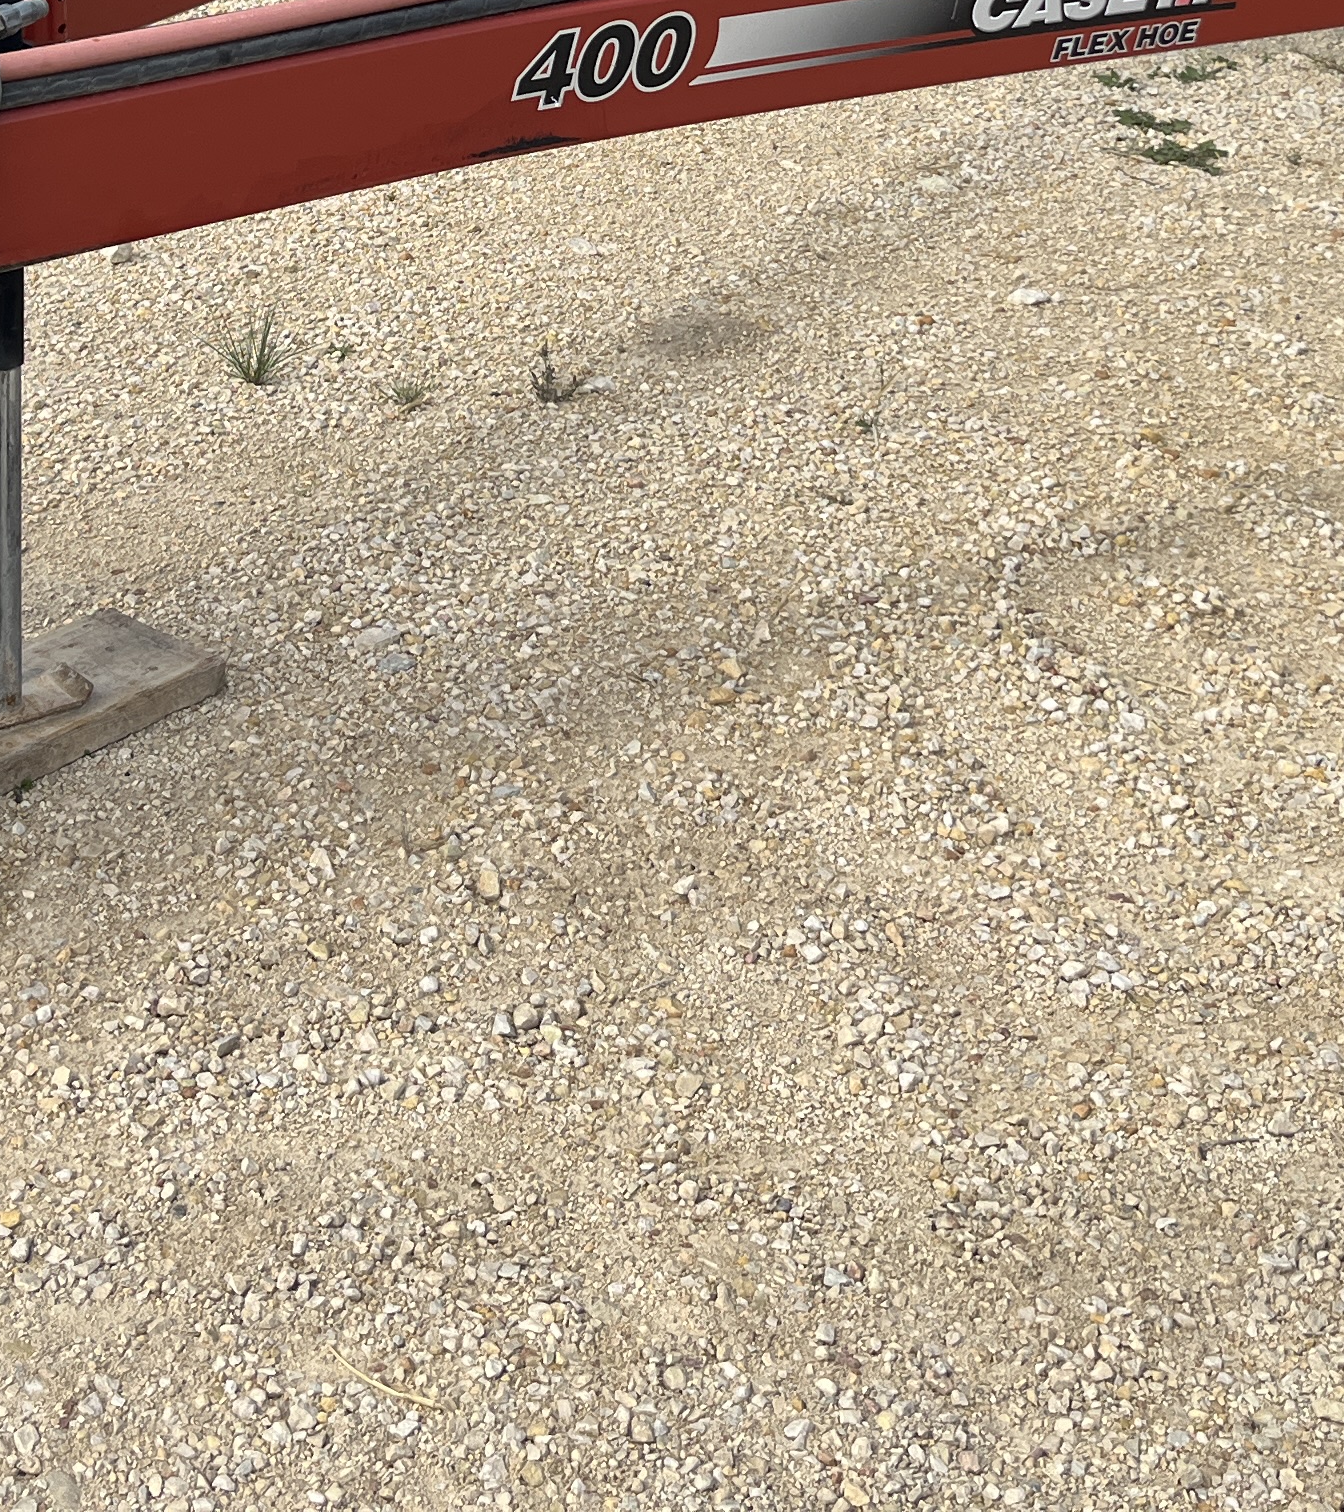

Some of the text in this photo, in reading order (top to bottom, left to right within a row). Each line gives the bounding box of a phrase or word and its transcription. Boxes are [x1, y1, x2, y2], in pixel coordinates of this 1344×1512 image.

[511, 10, 697, 111] 400
[1050, 18, 1202, 63] FLEX HOE
